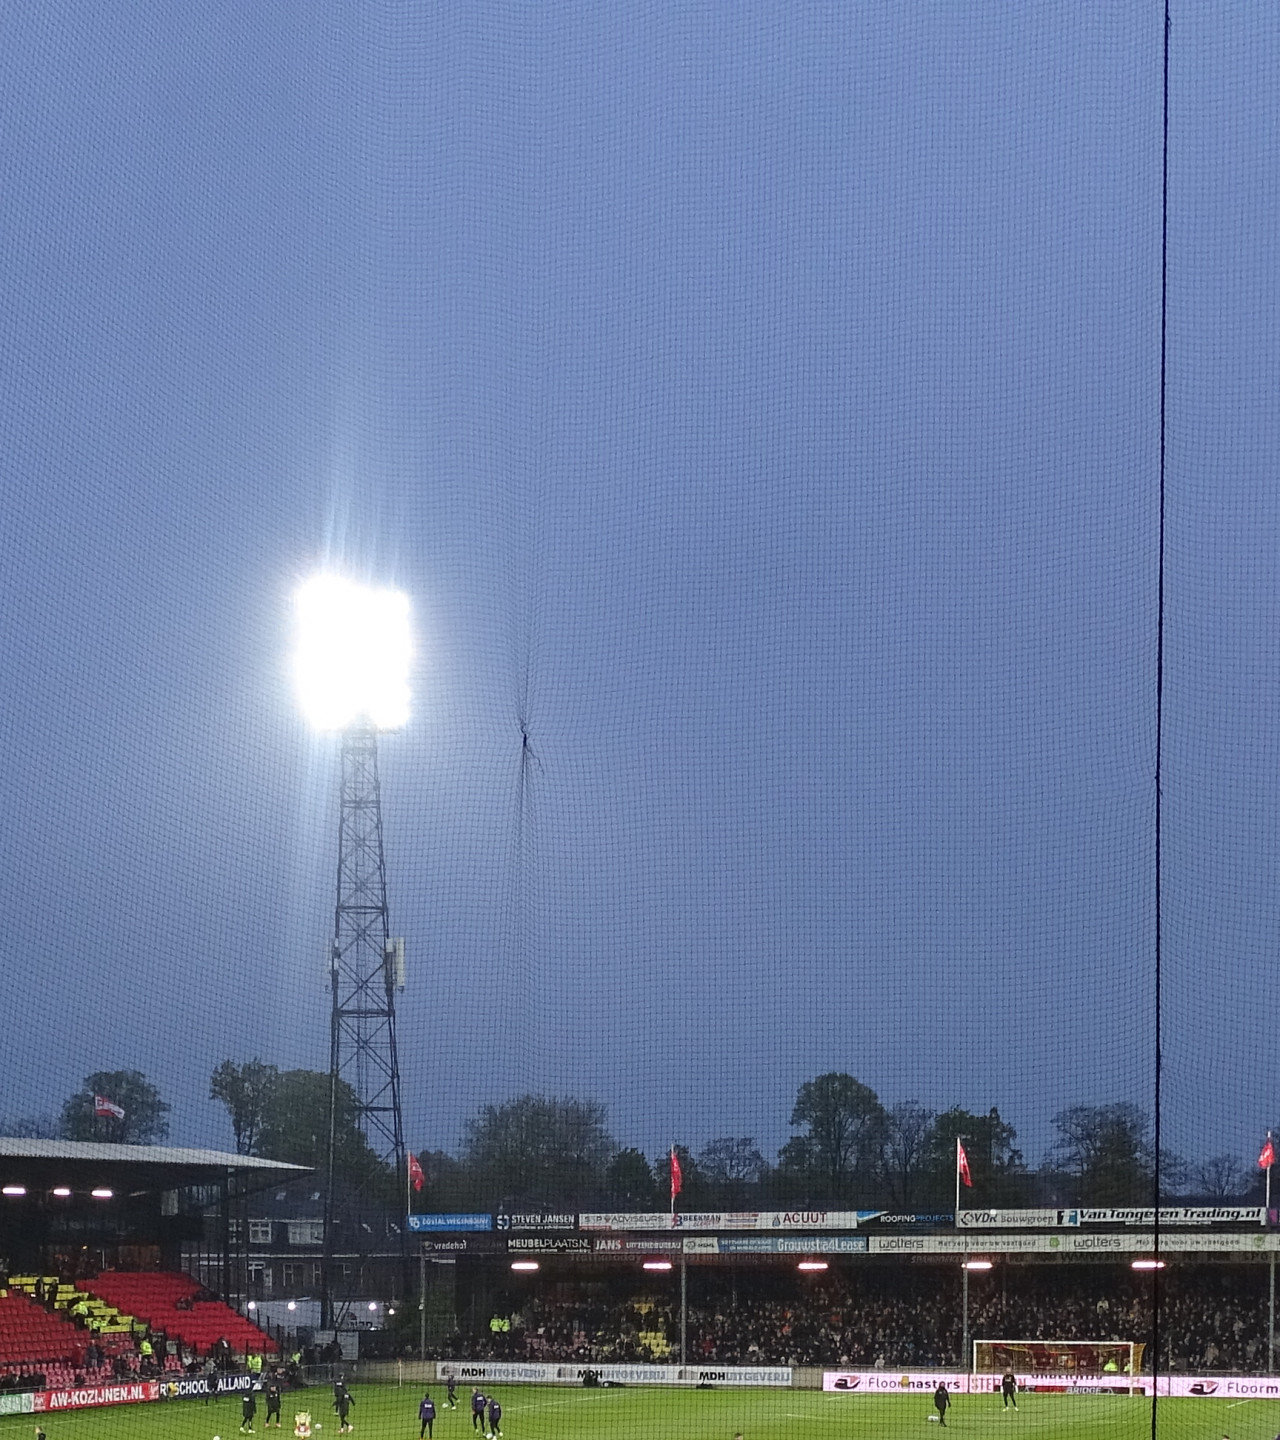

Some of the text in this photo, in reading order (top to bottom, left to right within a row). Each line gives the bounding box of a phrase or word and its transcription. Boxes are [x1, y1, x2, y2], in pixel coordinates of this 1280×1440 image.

[511, 1214, 575, 1224] STEVEN JANSEN
[783, 1213, 827, 1224] ACUUT
[1080, 1209, 1109, 1219] Van
[1183, 1207, 1261, 1221] Trading.nl
[1001, 1215, 1053, 1225] Bouwgroep
[507, 1238, 590, 1248] MEUBELPLAATS.NL
[596, 1239, 621, 1250] JANS
[625, 1241, 681, 1249] UITZENDBUREAU
[878, 1238, 924, 1250] wolters
[1073, 1237, 1121, 1249] wolters
[216, 1376, 251, 1393] ALLAND
[1066, 1386, 1102, 1394] BRIDGE
[49, 1385, 146, 1408] AW-KOZIJNEN.NL
